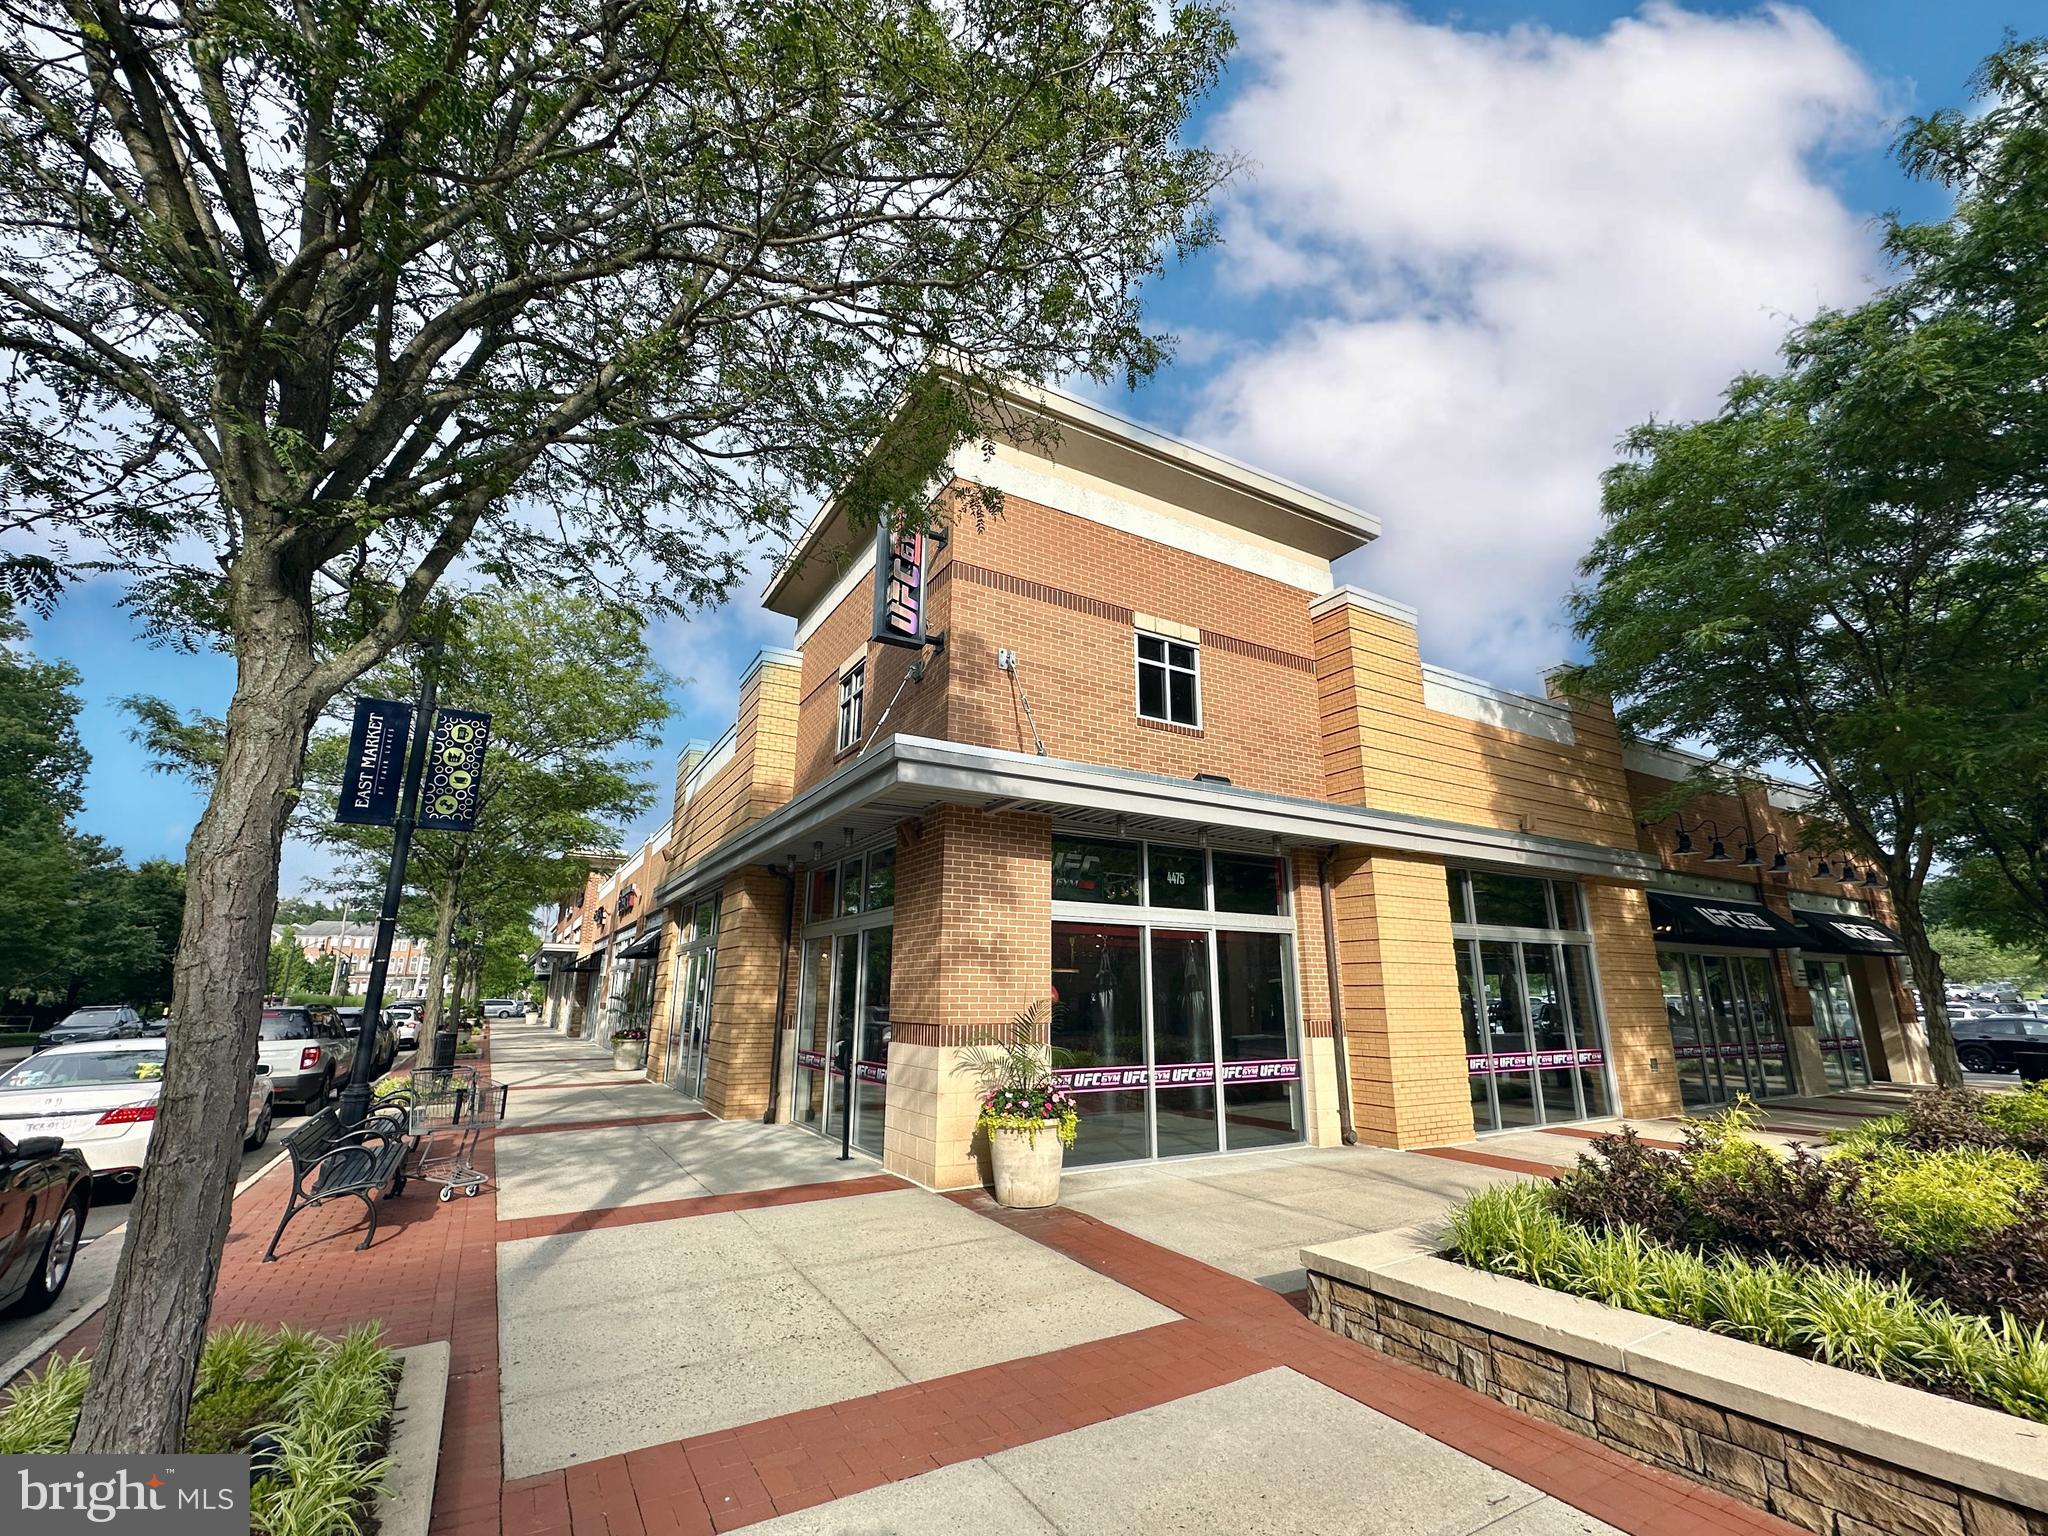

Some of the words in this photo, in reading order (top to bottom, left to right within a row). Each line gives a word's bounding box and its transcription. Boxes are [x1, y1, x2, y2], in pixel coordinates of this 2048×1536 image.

[889, 557, 920, 635] UFC
[361, 712, 384, 769] MARKET
[354, 772, 372, 809] EAST
[1166, 871, 1185, 885] 4475
[1693, 906, 1749, 928] UFC
[1470, 1058, 1486, 1069] UFC
[1500, 1056, 1515, 1067] UFC
[1553, 1054, 1567, 1064] UFC
[1579, 1053, 1592, 1063] UFC
[1074, 1073, 1102, 1087] UFC
[1101, 1074, 1121, 1083] GYM
[1122, 1070, 1148, 1084] UFC
[1172, 1068, 1197, 1082] UFC
[1196, 1069, 1213, 1078] GYM
[1222, 1066, 1243, 1079] UFC
[1242, 1067, 1259, 1076] GYM
[1260, 1064, 1281, 1077] UFC
[1280, 1065, 1296, 1074] GYM
